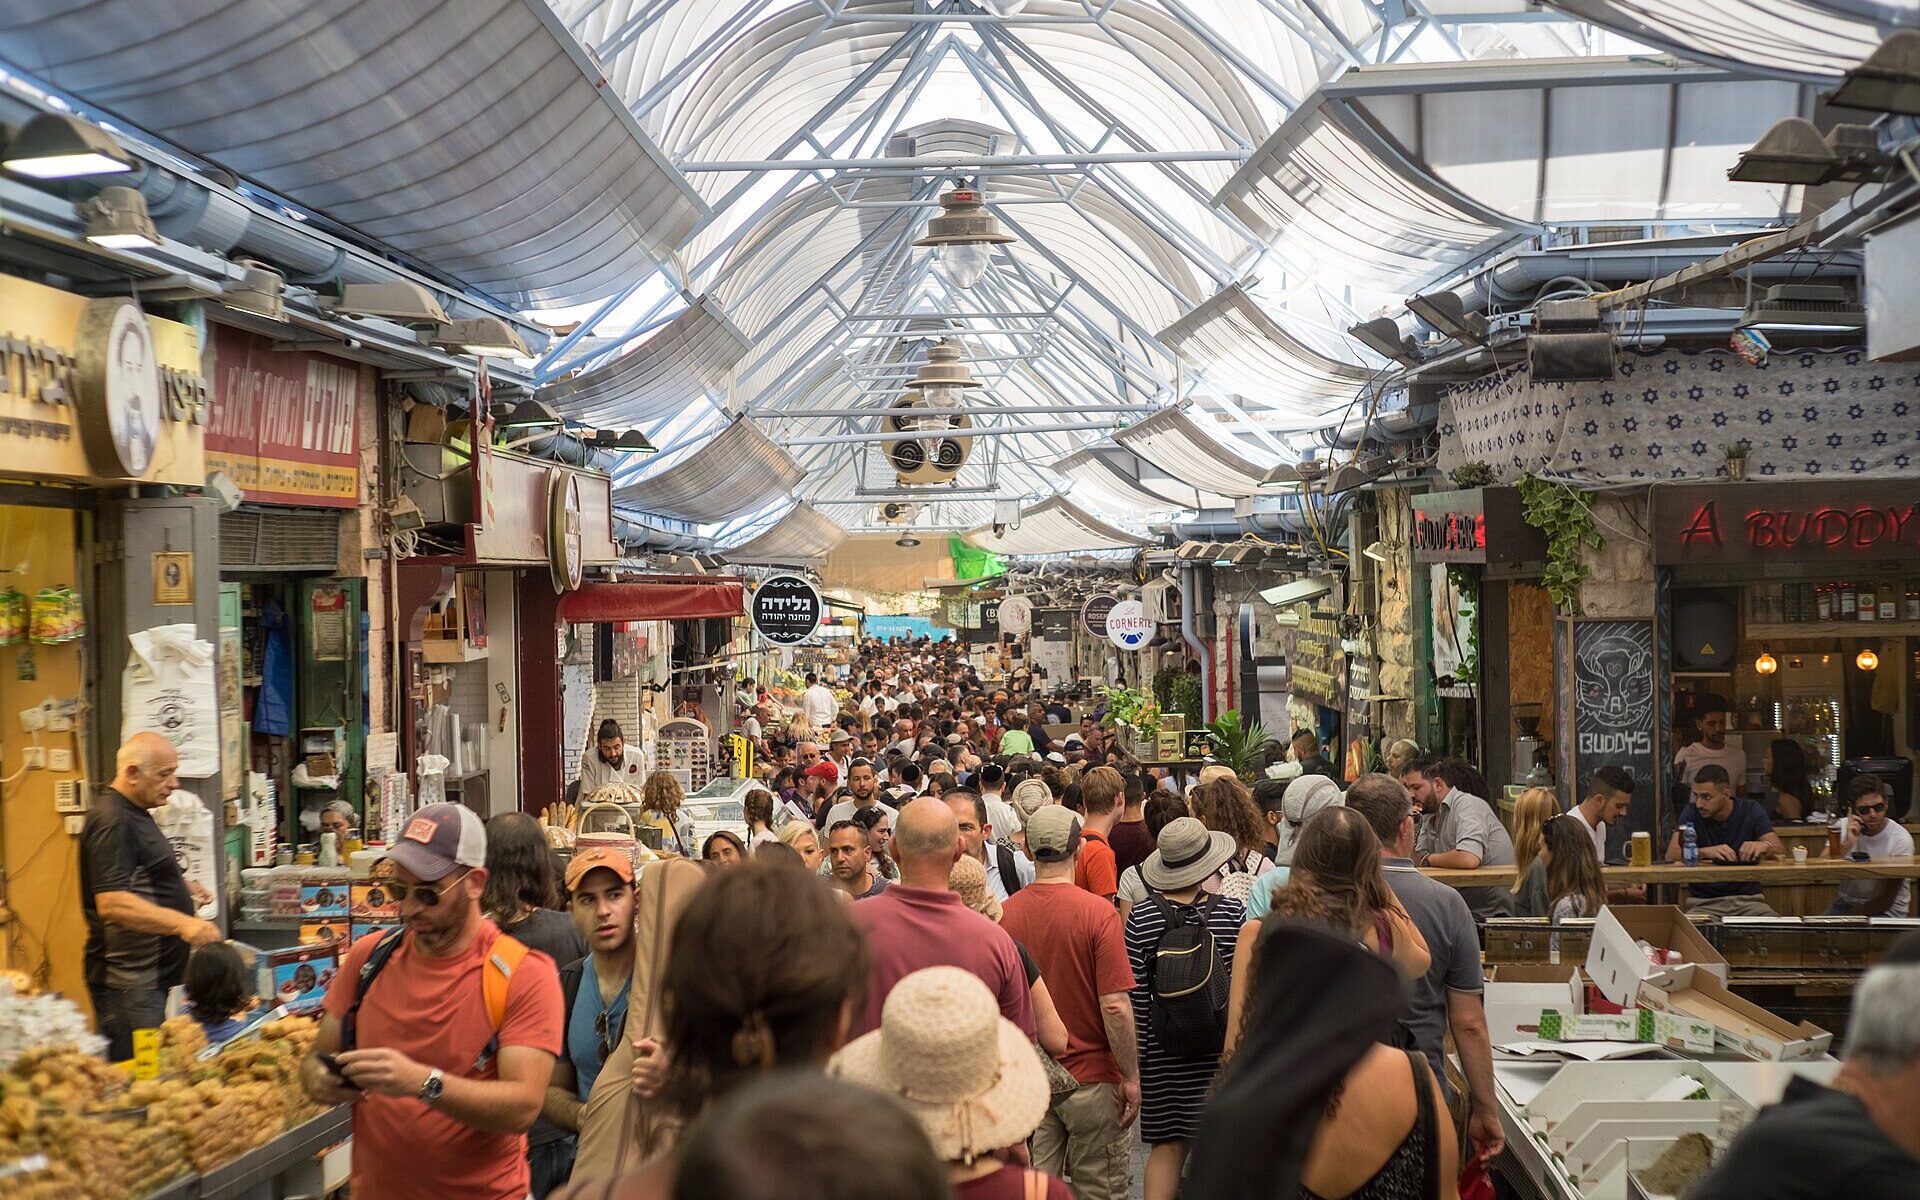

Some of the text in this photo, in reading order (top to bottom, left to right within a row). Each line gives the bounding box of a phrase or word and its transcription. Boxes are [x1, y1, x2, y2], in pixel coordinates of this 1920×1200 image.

[1680, 500, 1724, 549] A
[761, 595, 811, 611] גלידה
[762, 612, 811, 621] מחנה יהודה
[1610, 696, 1622, 713] A
[1578, 732, 1651, 756] BUDDYS
